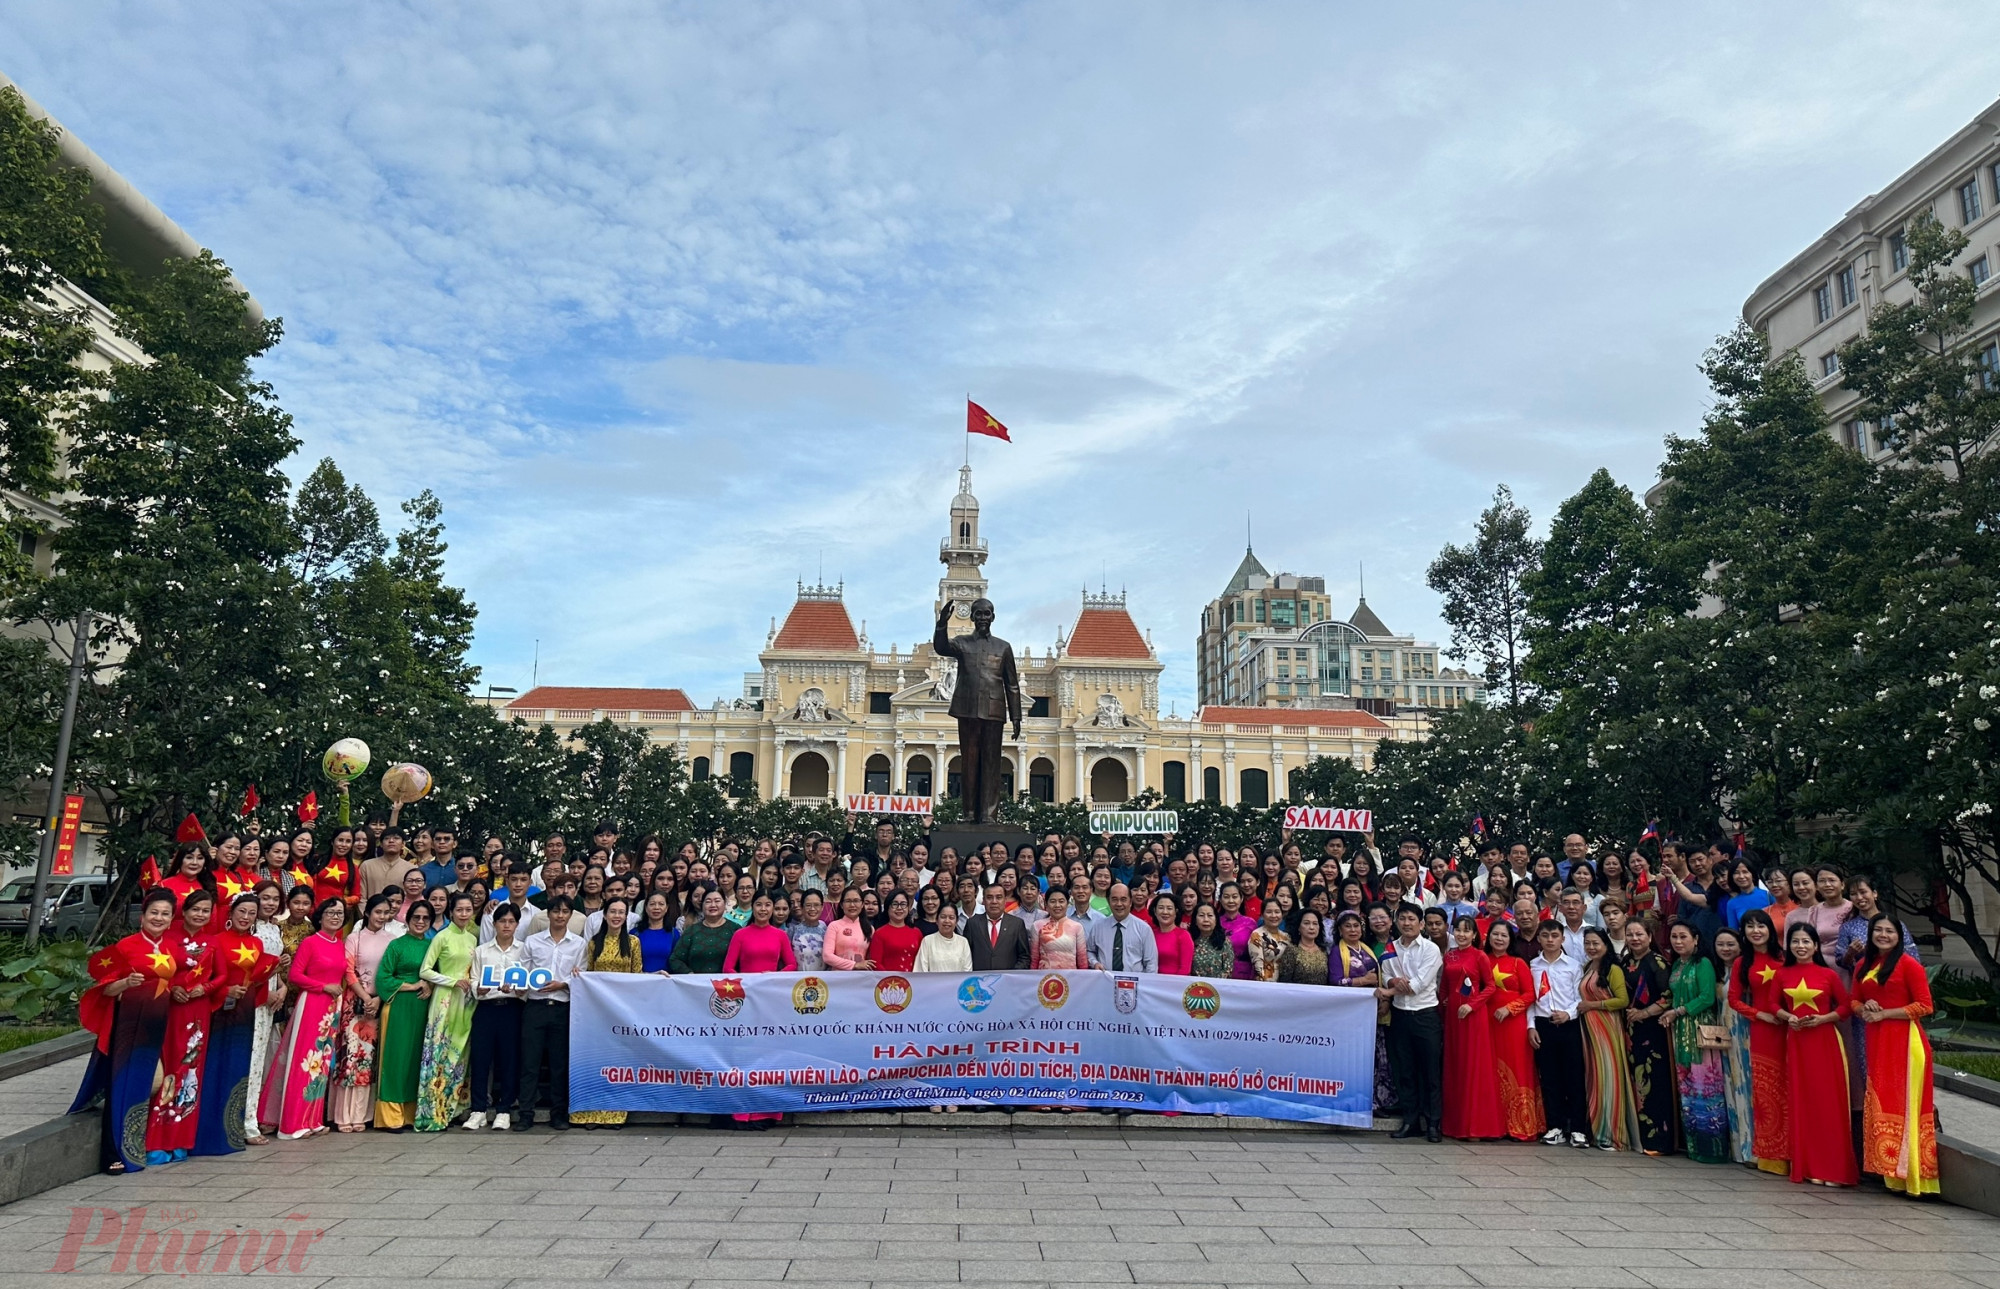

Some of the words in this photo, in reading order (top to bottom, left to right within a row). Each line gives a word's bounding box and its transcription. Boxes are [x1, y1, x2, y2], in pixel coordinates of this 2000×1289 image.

[890, 796, 930, 812] NAM
[1091, 812, 1177, 832] CAMPUCHIA
[1284, 807, 1370, 830] SAMAKI
[481, 963, 553, 990] LÀO
[612, 1024, 650, 1037] CHÀO
[653, 1024, 695, 1037] MỪNG
[699, 1023, 719, 1036] KỶ
[722, 1024, 758, 1038] NIỆM
[762, 1025, 775, 1036] 78
[778, 1023, 809, 1036] NĂM
[813, 1020, 851, 1037] QUỐC
[854, 1021, 903, 1034] KHÁNH
[907, 1021, 943, 1034] NƯỚC
[947, 1020, 984, 1035] CỘNG
[988, 1019, 1014, 1031] HÒA
[1018, 1018, 1036, 1030] XÃ
[1040, 1018, 1063, 1031] HỘI
[1067, 1018, 1095, 1031] CHỦ
[1098, 1022, 1140, 1036] NGHĨA
[1145, 1024, 1175, 1038] VIỆT
[1178, 1028, 1209, 1039] NAM
[1212, 1030, 1268, 1043] (02/9/1945
[1278, 1033, 1335, 1048] 02/9/2023)
[873, 1041, 974, 1059] HÀNH
[985, 1037, 1080, 1055] TRÌNH
[638, 1064, 675, 1084] ĐÌNH
[679, 1069, 714, 1089] VIỆT
[718, 1067, 744, 1087] VỚI
[748, 1070, 785, 1086] SINH
[789, 1066, 825, 1085] VIÊN
[830, 1064, 863, 1084] LÀO,
[867, 1062, 953, 1081] CAMPUCHIA
[957, 1057, 987, 1077] ĐẾN
[991, 1058, 1016, 1077] VỚI
[1020, 1062, 1035, 1077] DI
[1039, 1059, 1078, 1081] TÍCH,
[1081, 1063, 1106, 1083] ĐỊA
[1110, 1065, 1150, 1084] DANH
[1155, 1067, 1205, 1086] THÀNH
[1208, 1067, 1239, 1089] PHỐ
[1243, 1069, 1264, 1089] HỒ
[1267, 1073, 1293, 1092] CHÍ
[805, 1091, 849, 1103] Thành
[852, 1088, 881, 1104] phố
[881, 1087, 901, 1100] Hồ
[904, 1087, 930, 1099] Chí
[931, 1086, 971, 1099] Minh,
[974, 1087, 1006, 1099] ngày
[1008, 1087, 1025, 1097] 02
[1027, 1087, 1066, 1100] tháng
[1068, 1088, 1077, 1098] 9
[1080, 1090, 1109, 1100] năm
[1111, 1090, 1145, 1102] 2023
